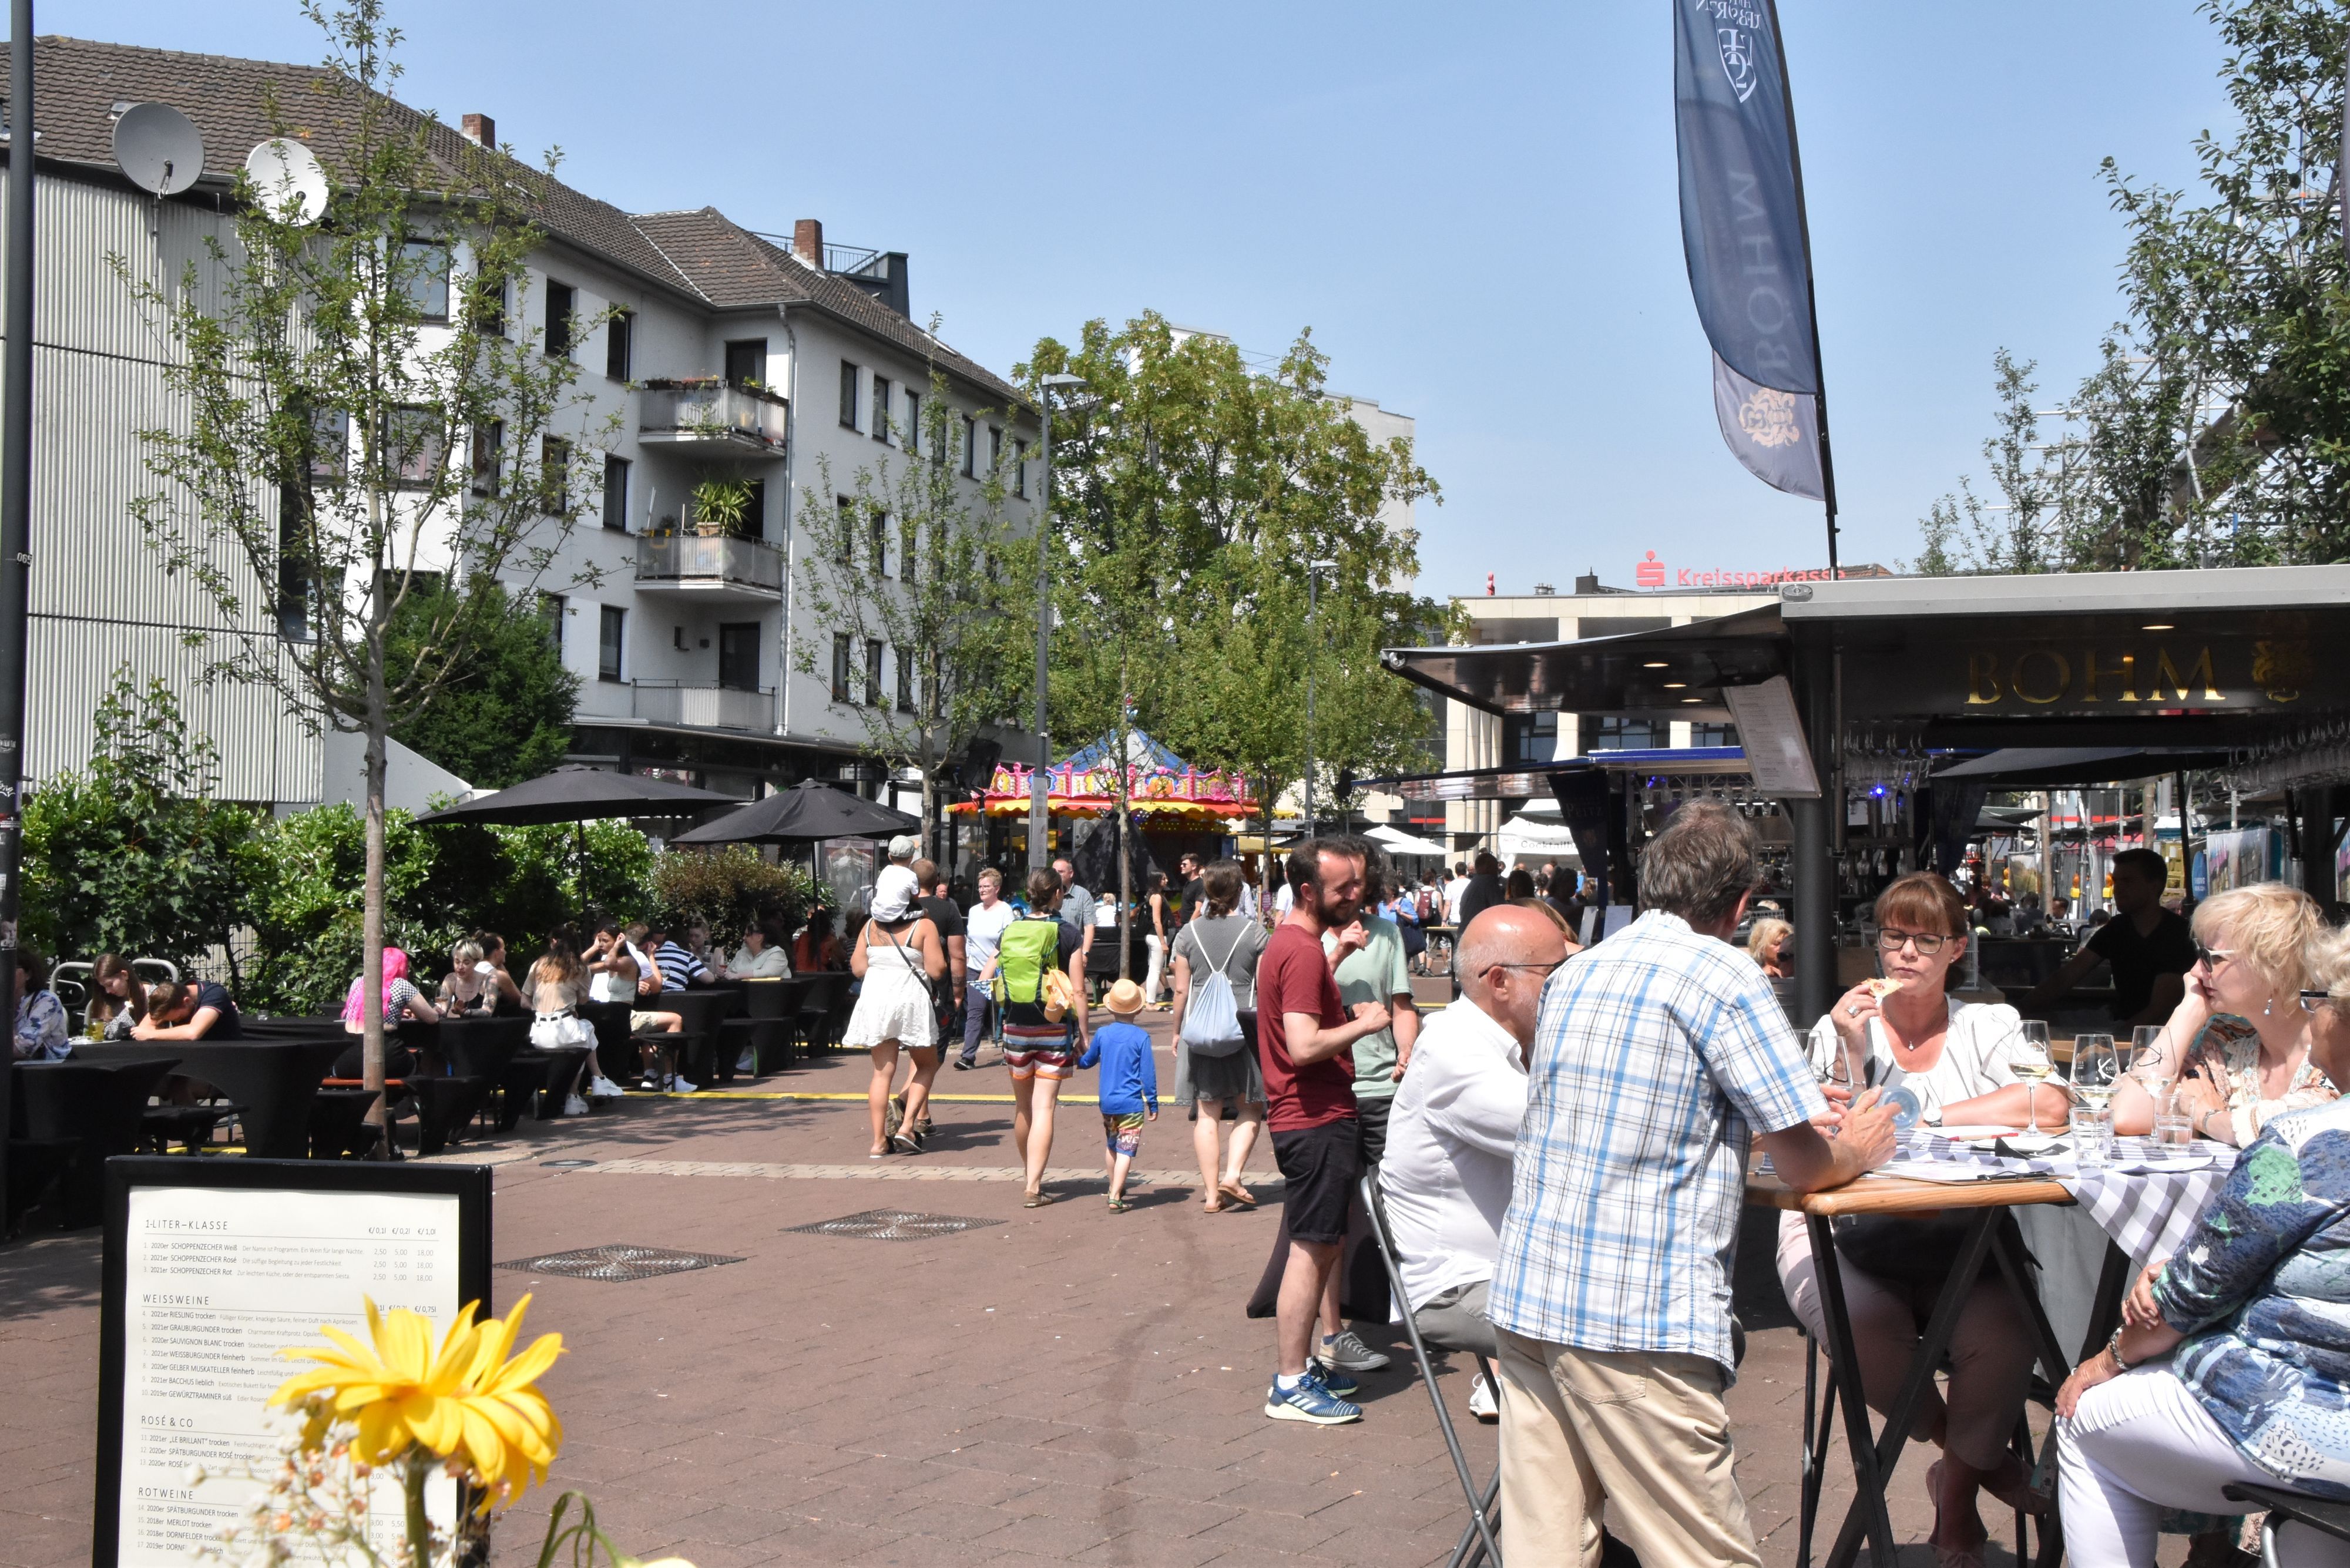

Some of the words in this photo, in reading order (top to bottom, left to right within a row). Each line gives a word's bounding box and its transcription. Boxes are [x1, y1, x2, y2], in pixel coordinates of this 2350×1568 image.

[17, 552, 33, 565] 065
[143, 1294, 209, 1305] WEISSWEINE
[170, 1324, 220, 1333] GRAUBURGUNDER
[170, 1337, 203, 1346] SAUVIGNON
[169, 1351, 220, 1360] WEISSBURGUNDER
[221, 1353, 245, 1361] feinherb
[191, 1365, 229, 1374] MUSKATELLER
[231, 1366, 255, 1375] feinherb
[169, 1377, 194, 1385] BACCHUS
[195, 1379, 214, 1387] lieblich
[169, 1390, 221, 1401] GEWÜRZTRAMINER
[141, 1415, 166, 1426] ROSÉ
[169, 1417, 176, 1426] &
[179, 1418, 193, 1428] CO
[169, 1448, 217, 1458] SPÄTBURGUNDER
[219, 1451, 233, 1459] ROSÉ
[168, 1460, 183, 1468] ROSÉ
[138, 1487, 193, 1499] ROTWEINE
[166, 1505, 216, 1516] SPÄTBURGUNDER
[166, 1518, 190, 1527] MERLOT
[166, 1530, 203, 1540] DORNFELDER
